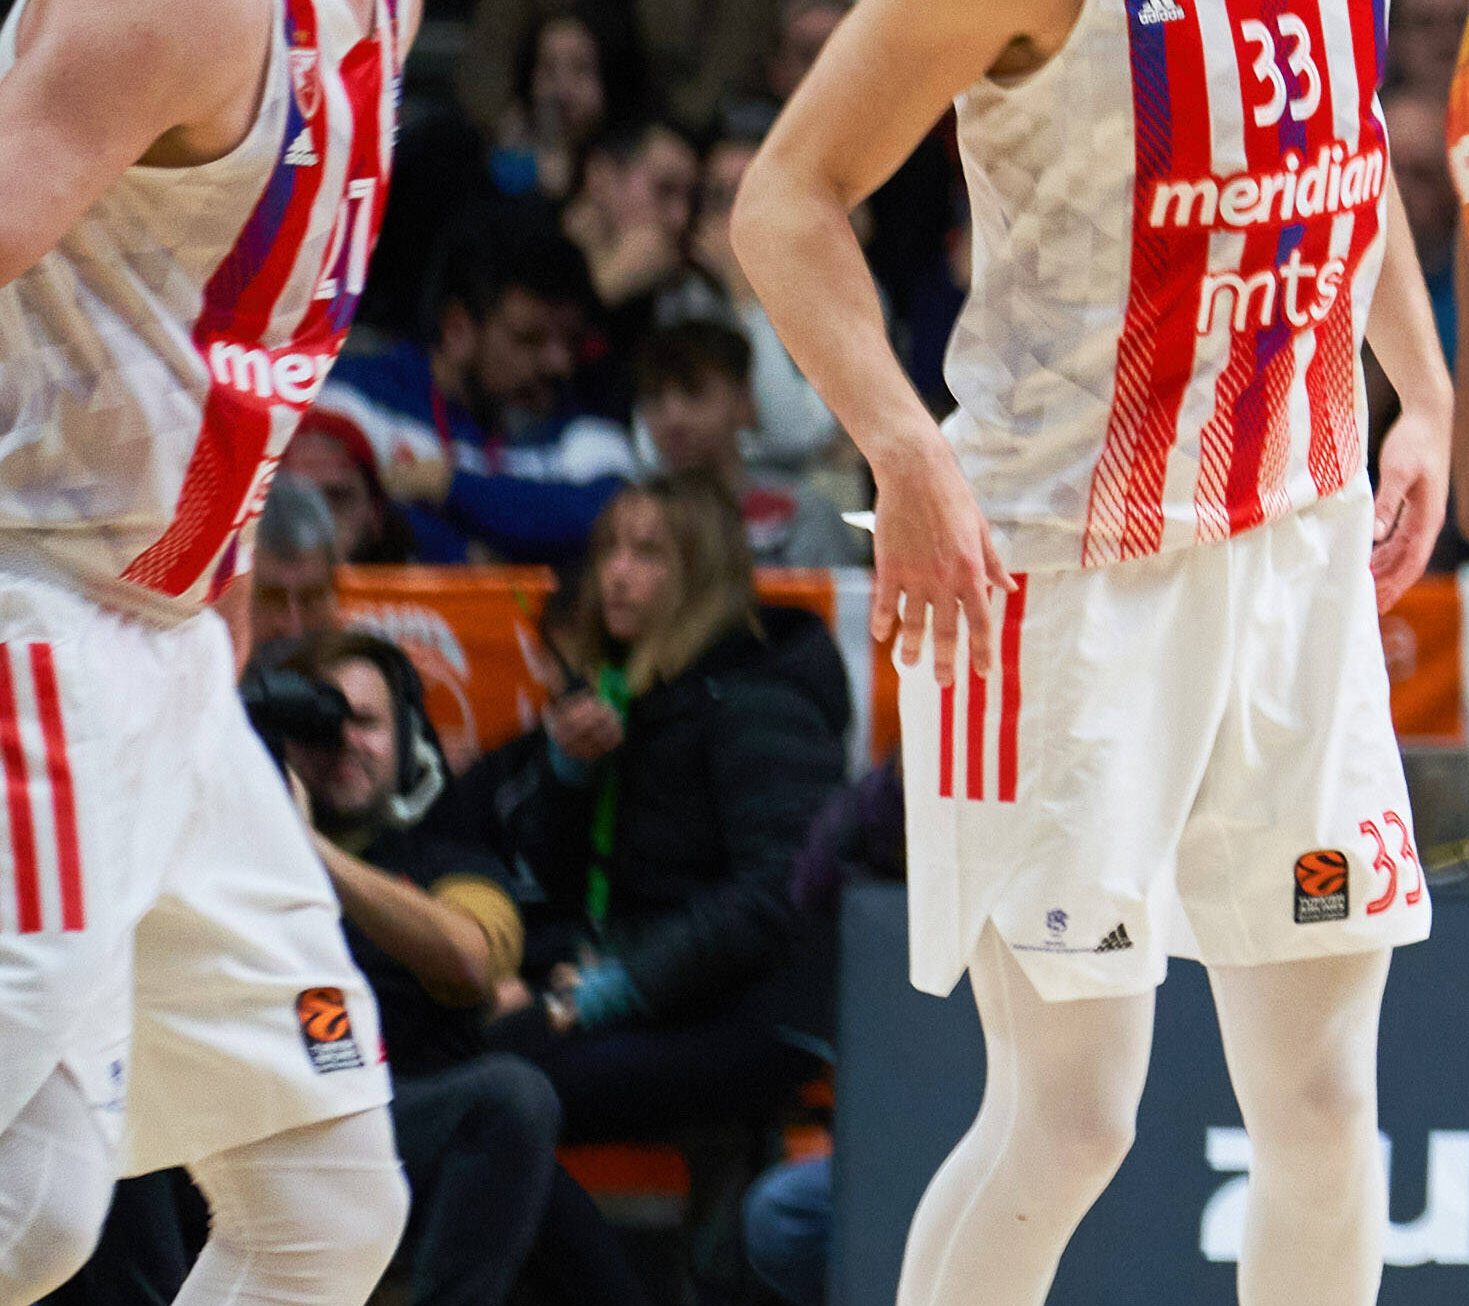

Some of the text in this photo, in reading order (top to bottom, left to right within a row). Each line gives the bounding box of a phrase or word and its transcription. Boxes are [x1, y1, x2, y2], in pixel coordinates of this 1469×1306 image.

[1241, 13, 1322, 128] 33
[1149, 144, 1384, 228] meridian
[1197, 248, 1346, 334] mts
[1360, 810, 1421, 916] 33
